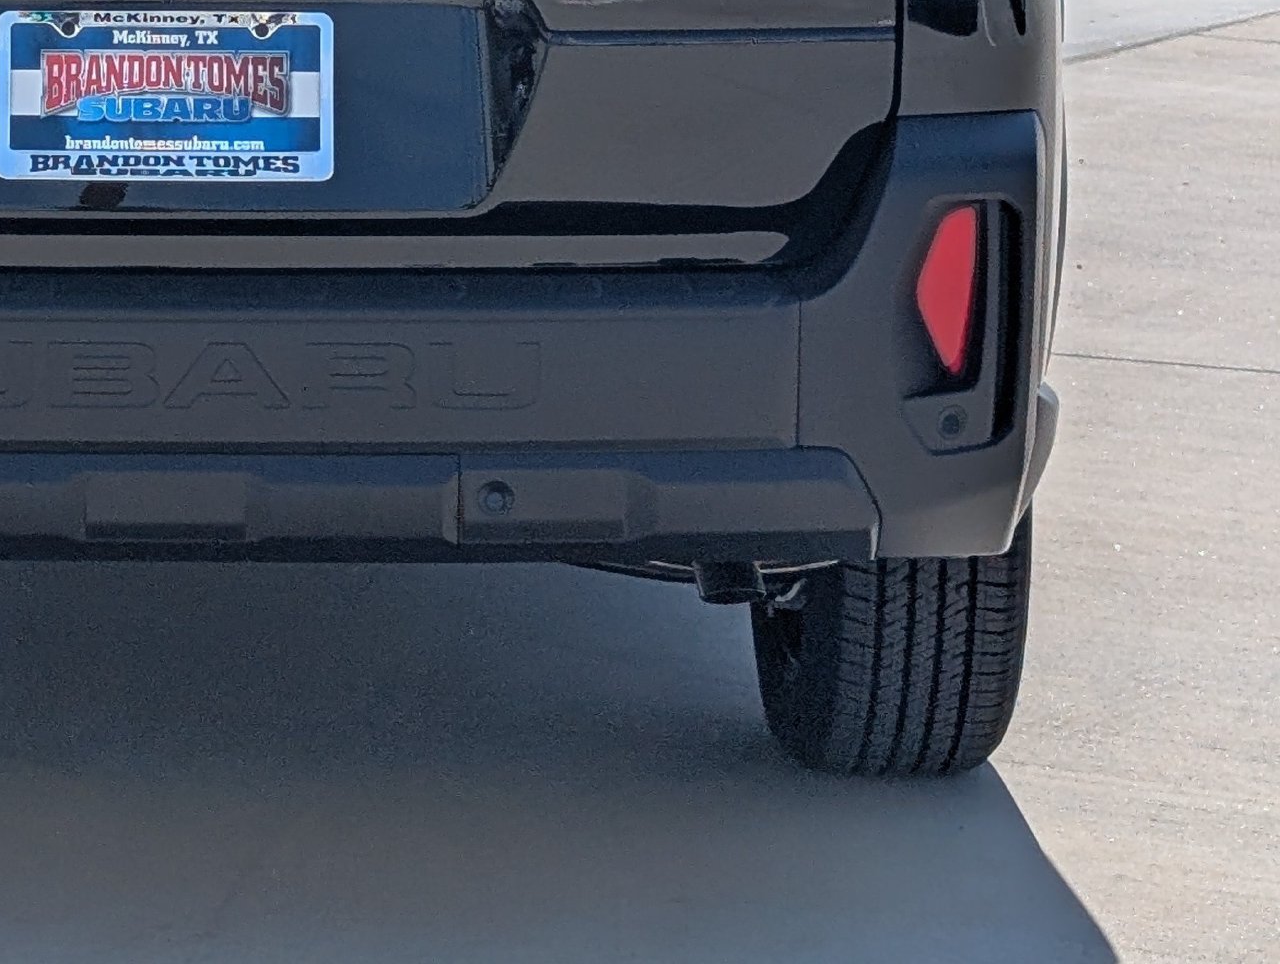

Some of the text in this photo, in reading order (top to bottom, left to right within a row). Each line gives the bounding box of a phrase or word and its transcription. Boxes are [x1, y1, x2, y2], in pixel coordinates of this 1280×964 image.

[93, 12, 205, 25] McKinney,
[112, 30, 219, 47] McKinney, TX
[44, 54, 288, 114] BRANDON TOMES
[79, 96, 250, 121] SUBARU
[65, 135, 264, 151] brandontomessubaru.com
[30, 154, 299, 173] BRANDON TOMES
